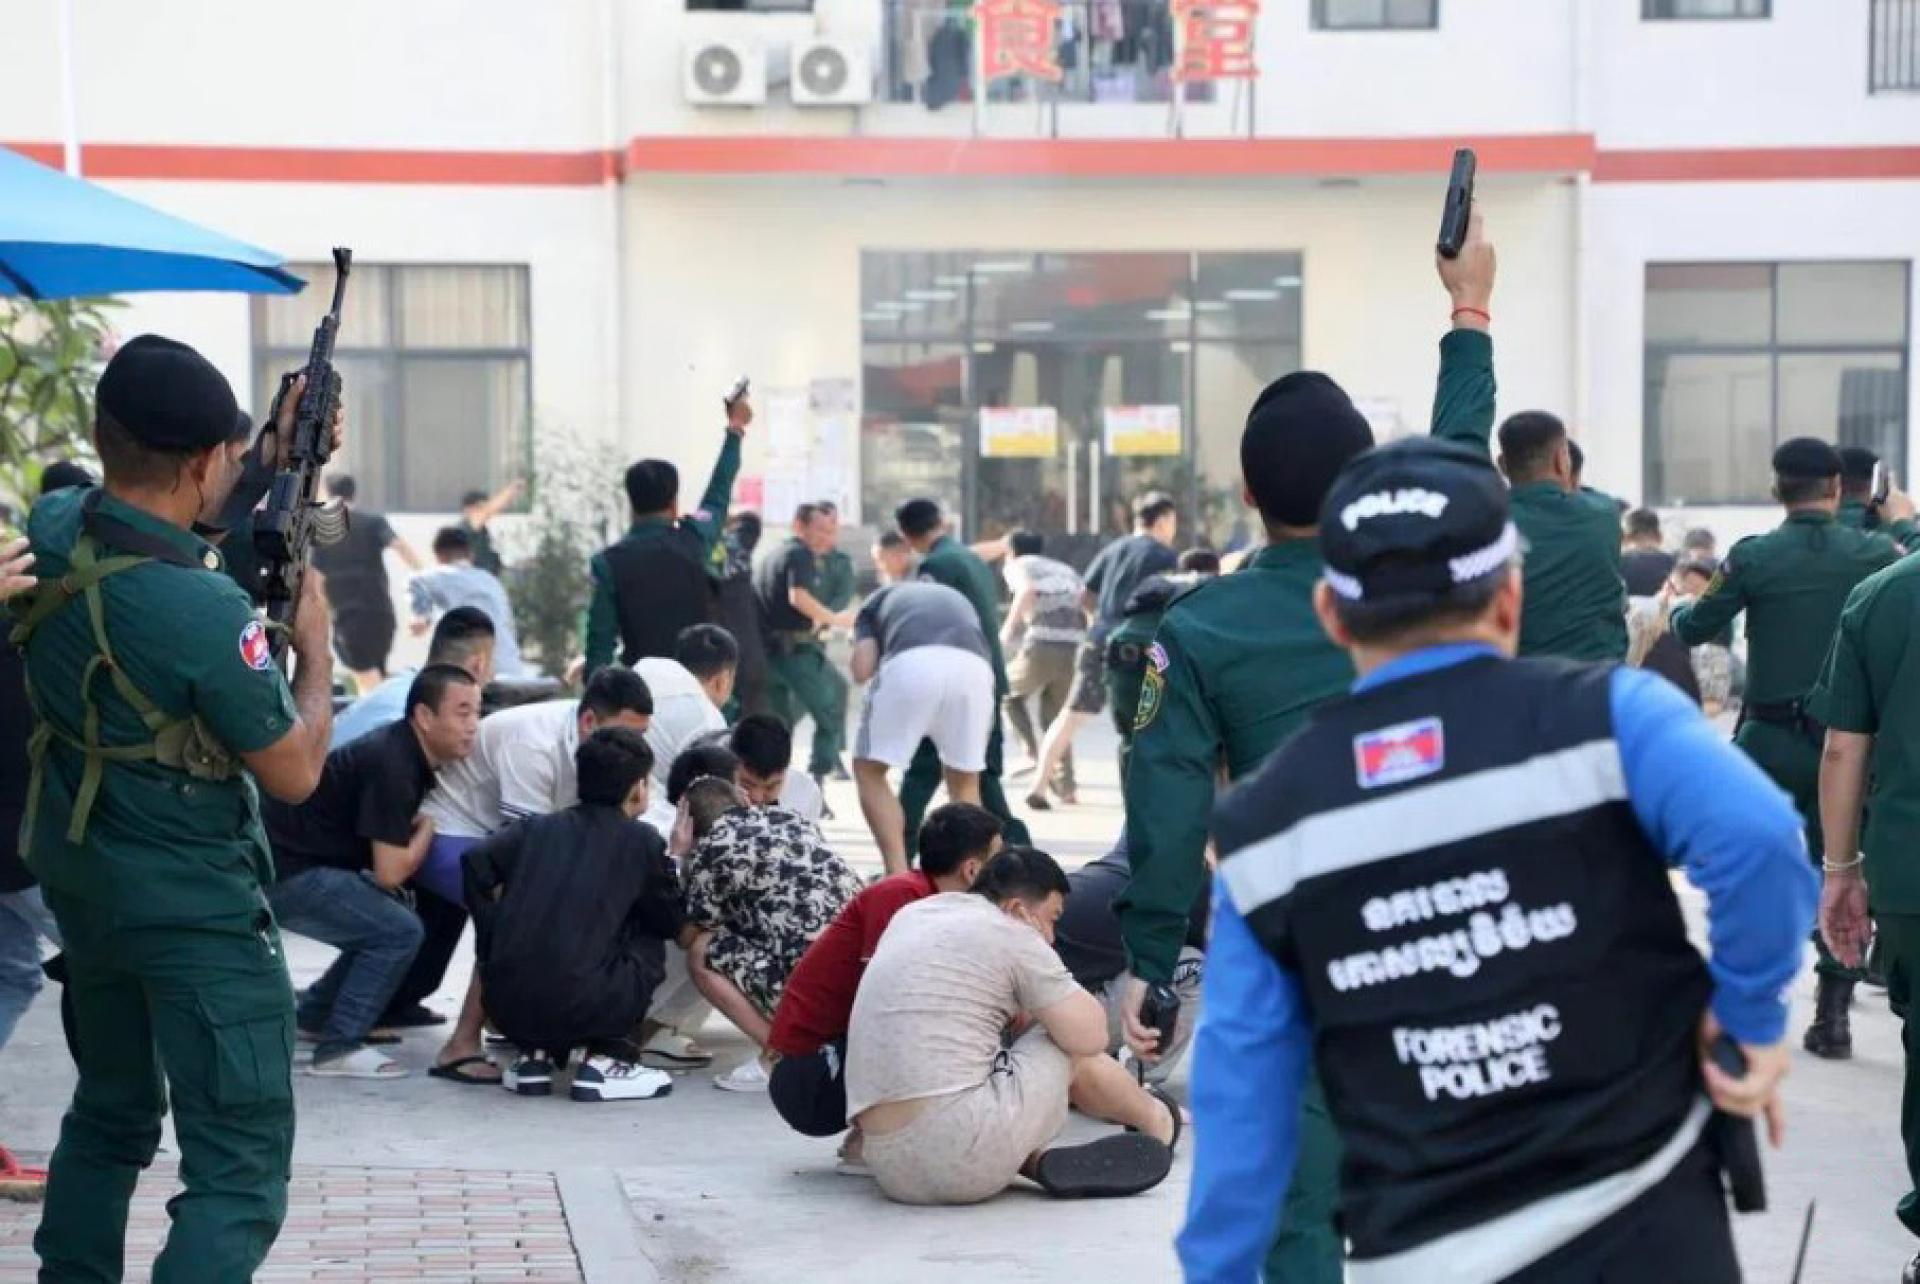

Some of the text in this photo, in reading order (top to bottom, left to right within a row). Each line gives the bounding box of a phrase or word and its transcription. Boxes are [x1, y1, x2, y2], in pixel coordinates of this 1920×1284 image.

[1341, 487, 1450, 530] POLICE
[1393, 1003, 1562, 1066] FORENSIC
[1419, 1044, 1551, 1101] POLICE
